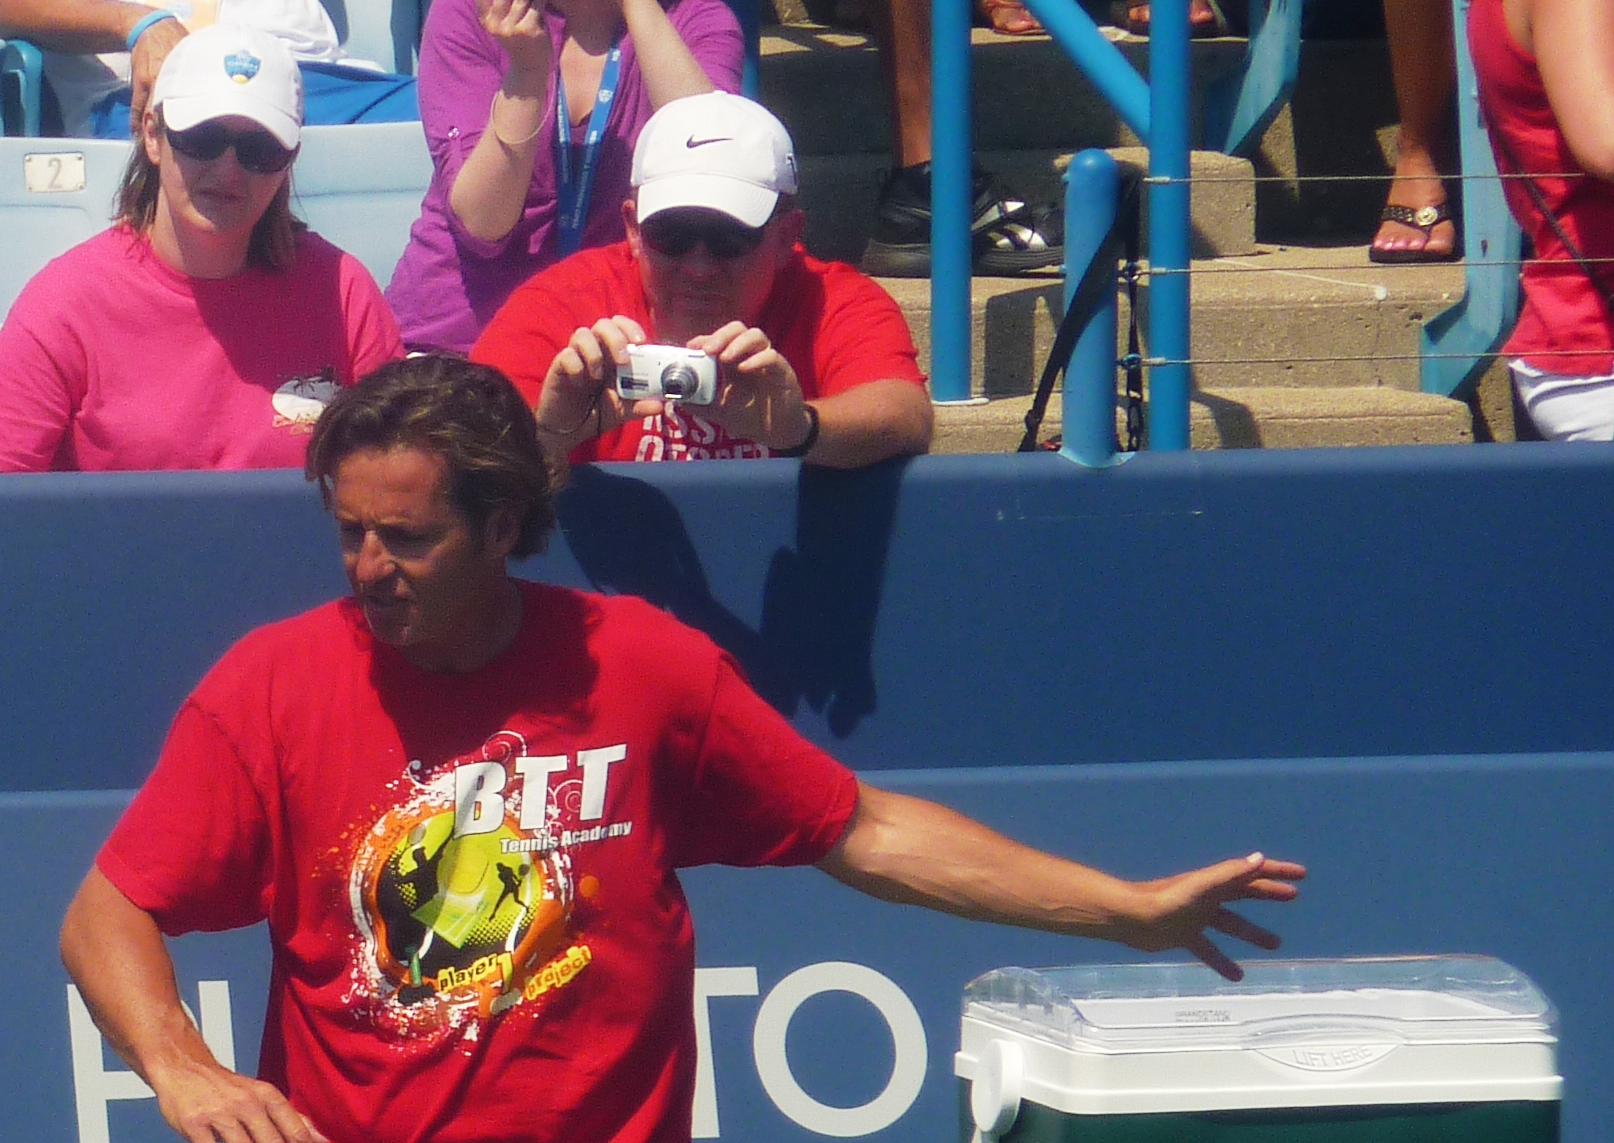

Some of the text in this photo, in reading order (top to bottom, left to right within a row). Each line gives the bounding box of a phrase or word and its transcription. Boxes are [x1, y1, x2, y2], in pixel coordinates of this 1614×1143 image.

[47, 157, 63, 190] 2
[454, 743, 627, 839] BTT
[500, 821, 633, 854] Tennis Academy
[439, 953, 497, 992] player
[526, 945, 592, 1000] project
[1293, 1046, 1374, 1068] LIFT HERE
